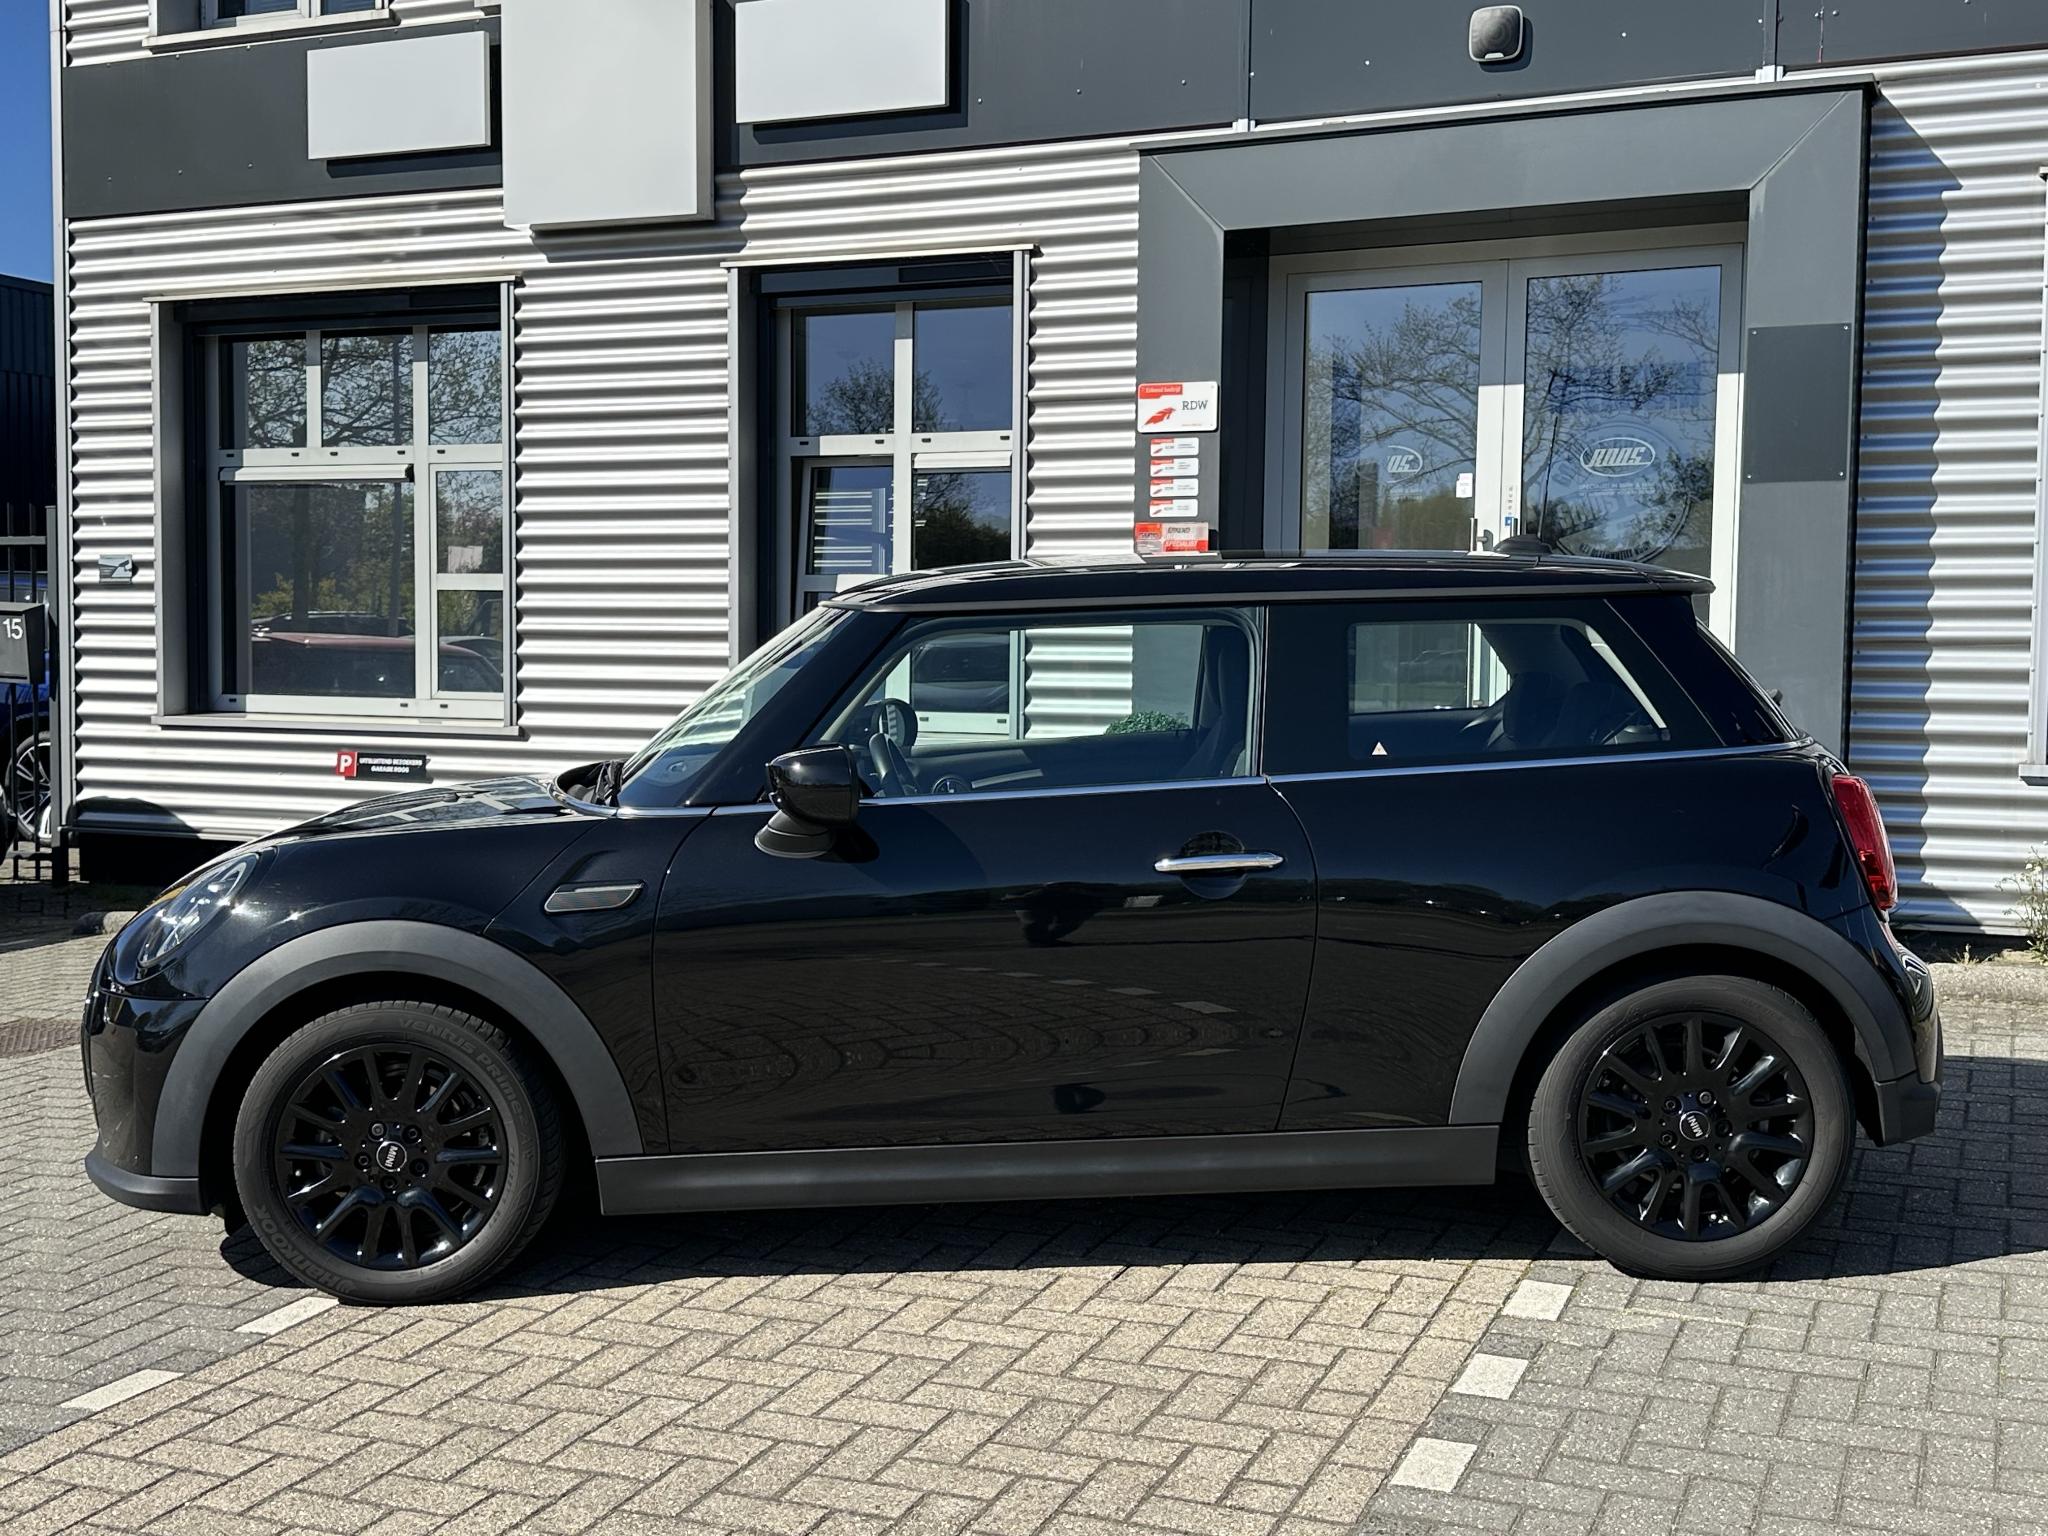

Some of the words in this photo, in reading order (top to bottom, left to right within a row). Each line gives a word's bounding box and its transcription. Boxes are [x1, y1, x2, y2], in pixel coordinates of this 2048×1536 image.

[1182, 400, 1208, 411] RDW
[3, 618, 23, 639] 15
[340, 754, 352, 773] P
[1687, 1115, 1703, 1137] MINI
[385, 1145, 398, 1167] MINI
